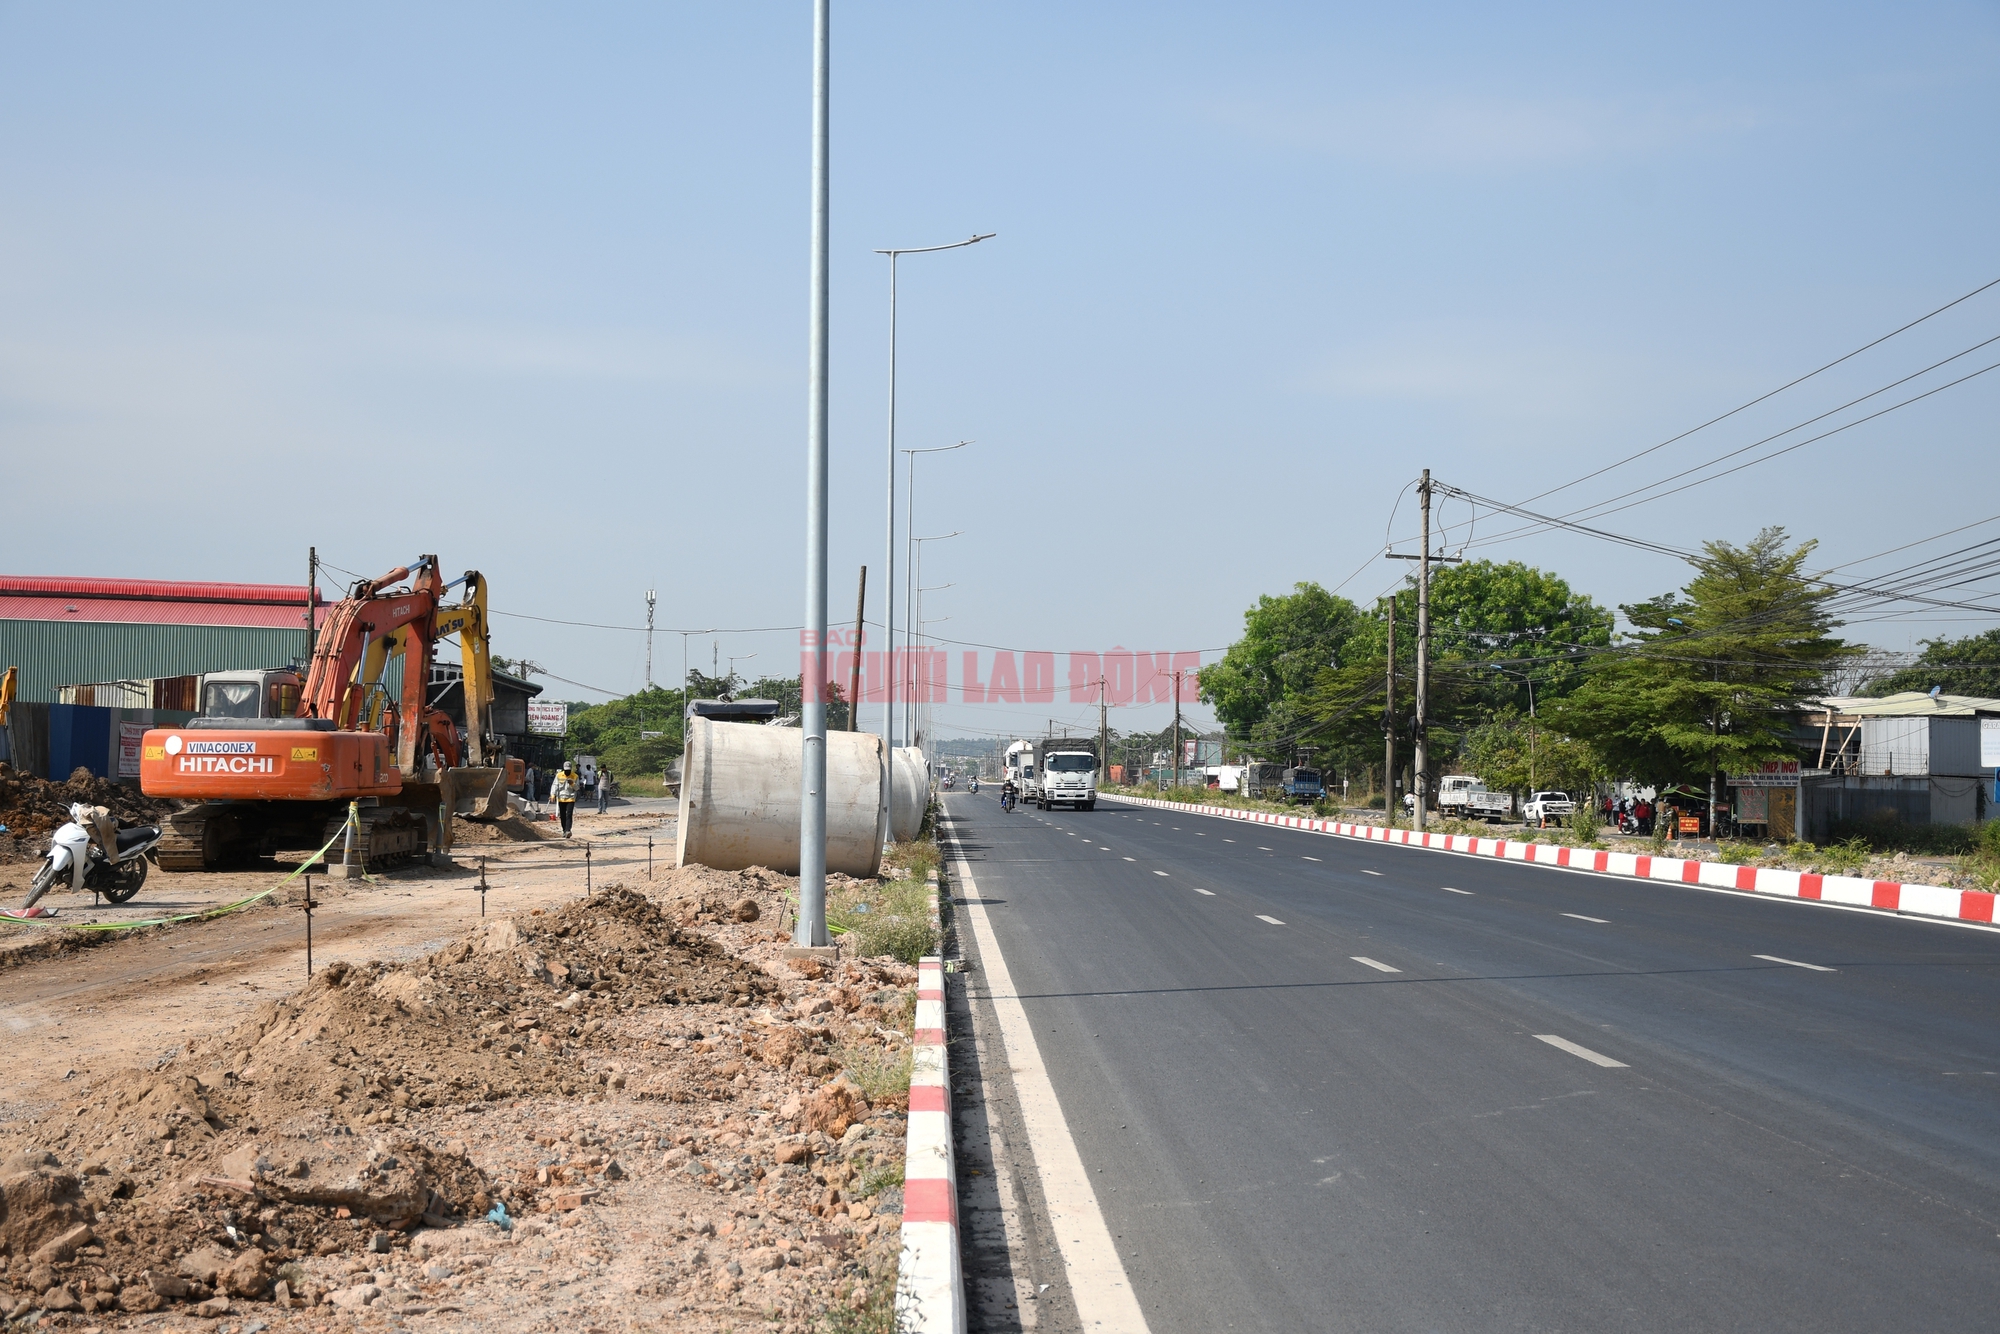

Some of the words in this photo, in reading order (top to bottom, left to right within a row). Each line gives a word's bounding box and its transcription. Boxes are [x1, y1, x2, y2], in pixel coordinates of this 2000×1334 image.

[392, 604, 411, 618] HITACHI
[189, 743, 254, 753] VINACONEX
[180, 756, 273, 773] HITACHI
[1781, 761, 1799, 773] INOX
